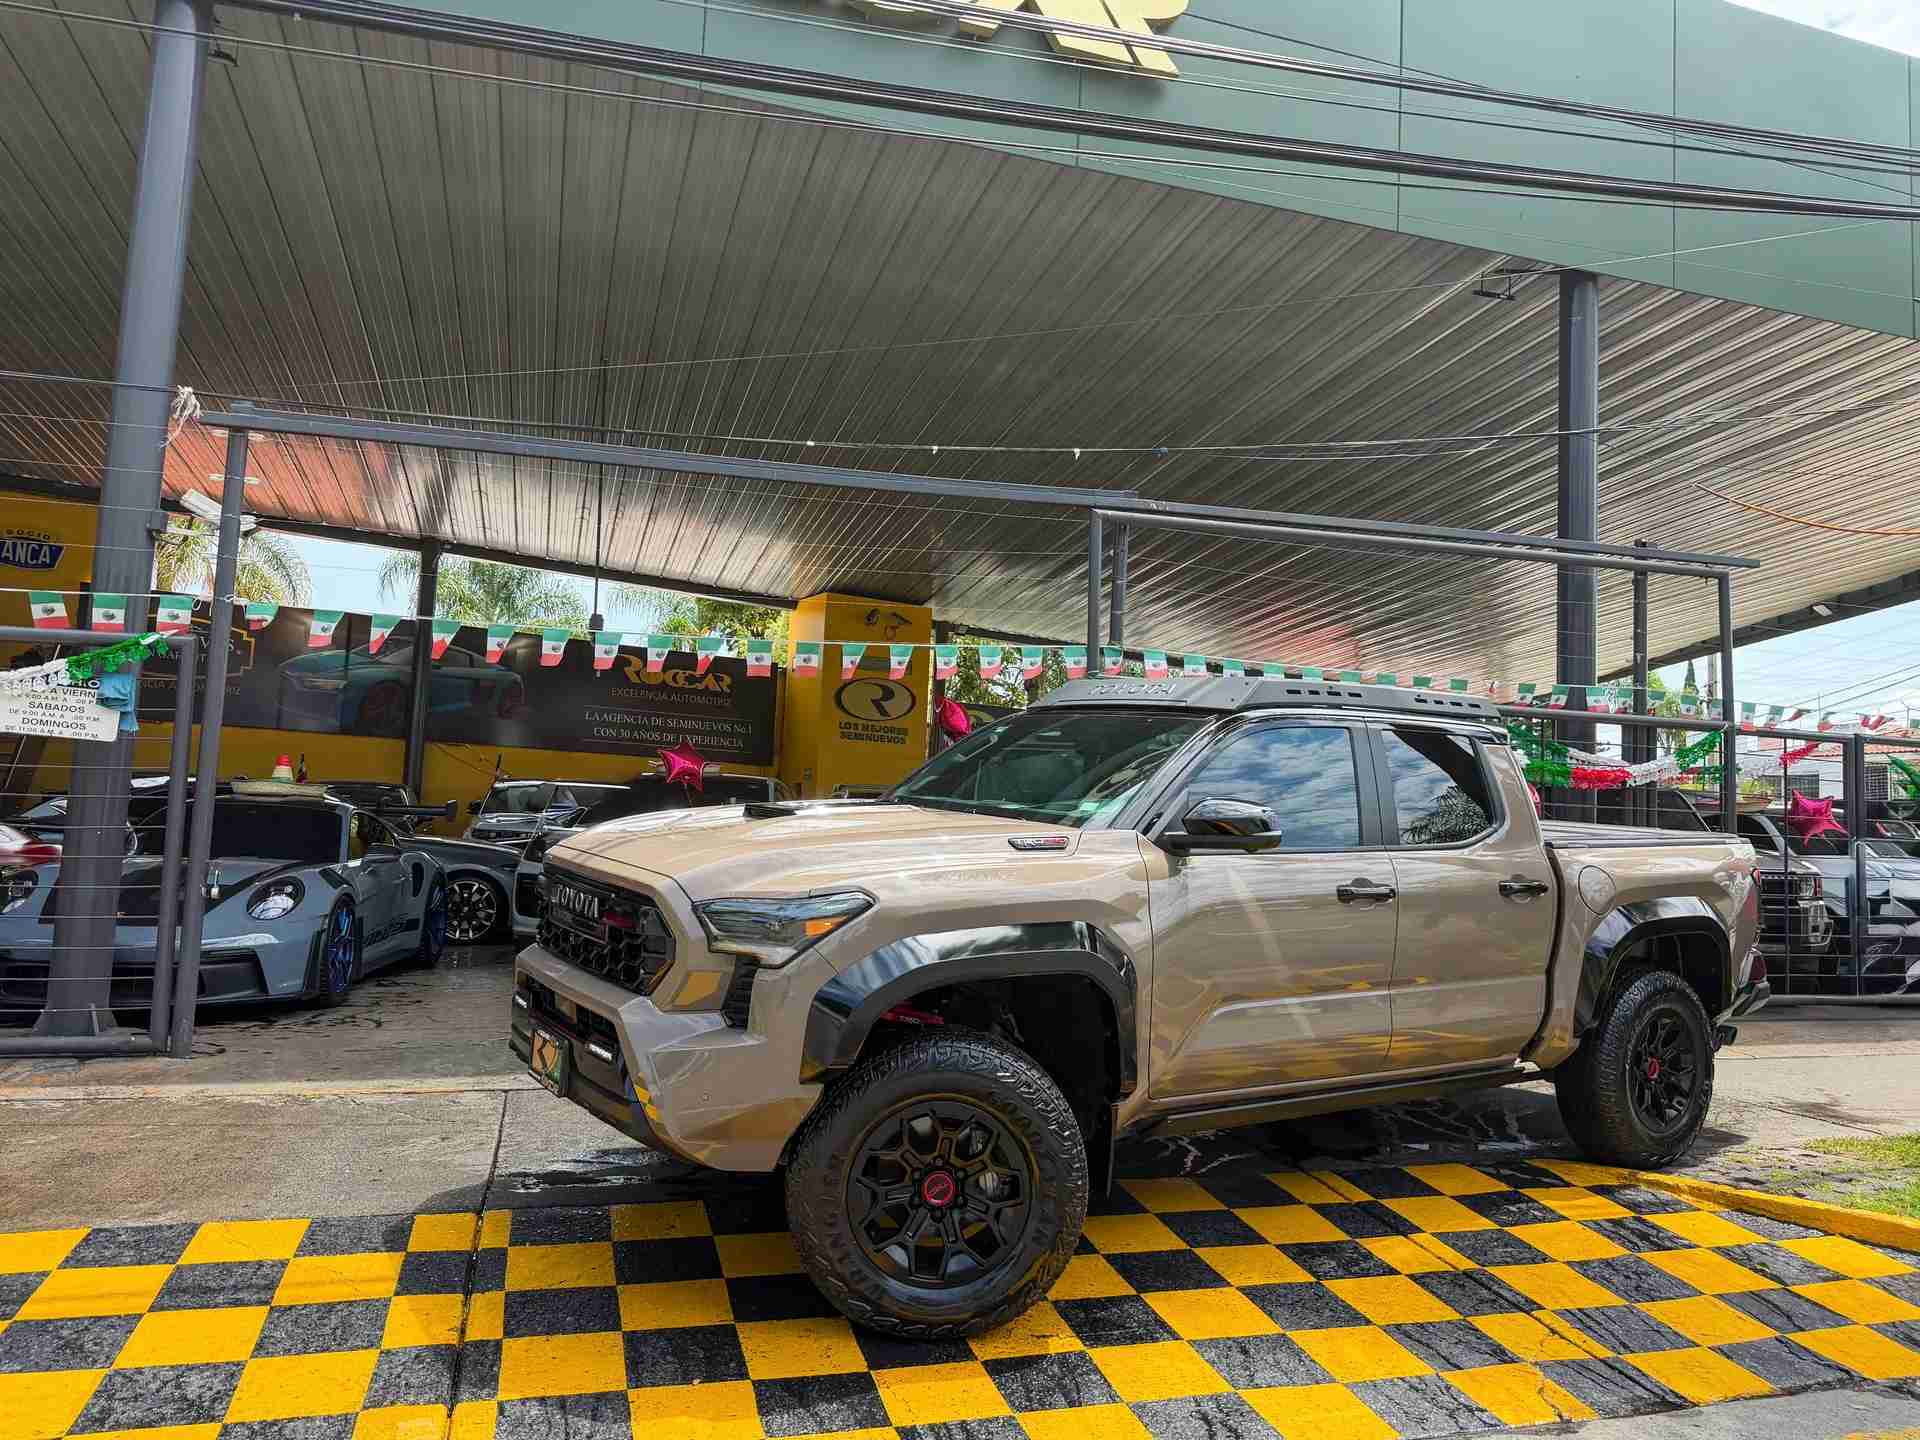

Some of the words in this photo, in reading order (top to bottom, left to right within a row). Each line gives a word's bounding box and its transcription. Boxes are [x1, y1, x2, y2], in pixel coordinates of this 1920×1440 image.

[0, 540, 50, 565] ANCA
[62, 688, 96, 699] VIERN
[28, 700, 86, 714] SABADOS
[21, 717, 87, 731] DOMINGOS
[585, 711, 600, 721] LA
[603, 713, 649, 726] AGENCIA
[651, 717, 665, 727] DE
[667, 718, 732, 733] SEMINUEVOS
[594, 727, 617, 738] CON
[619, 728, 631, 738] 30
[632, 727, 661, 742] AÑOS
[663, 733, 677, 743] DE
[679, 733, 744, 748] EXPERIENCIA
[551, 884, 599, 919] TOYOTA
